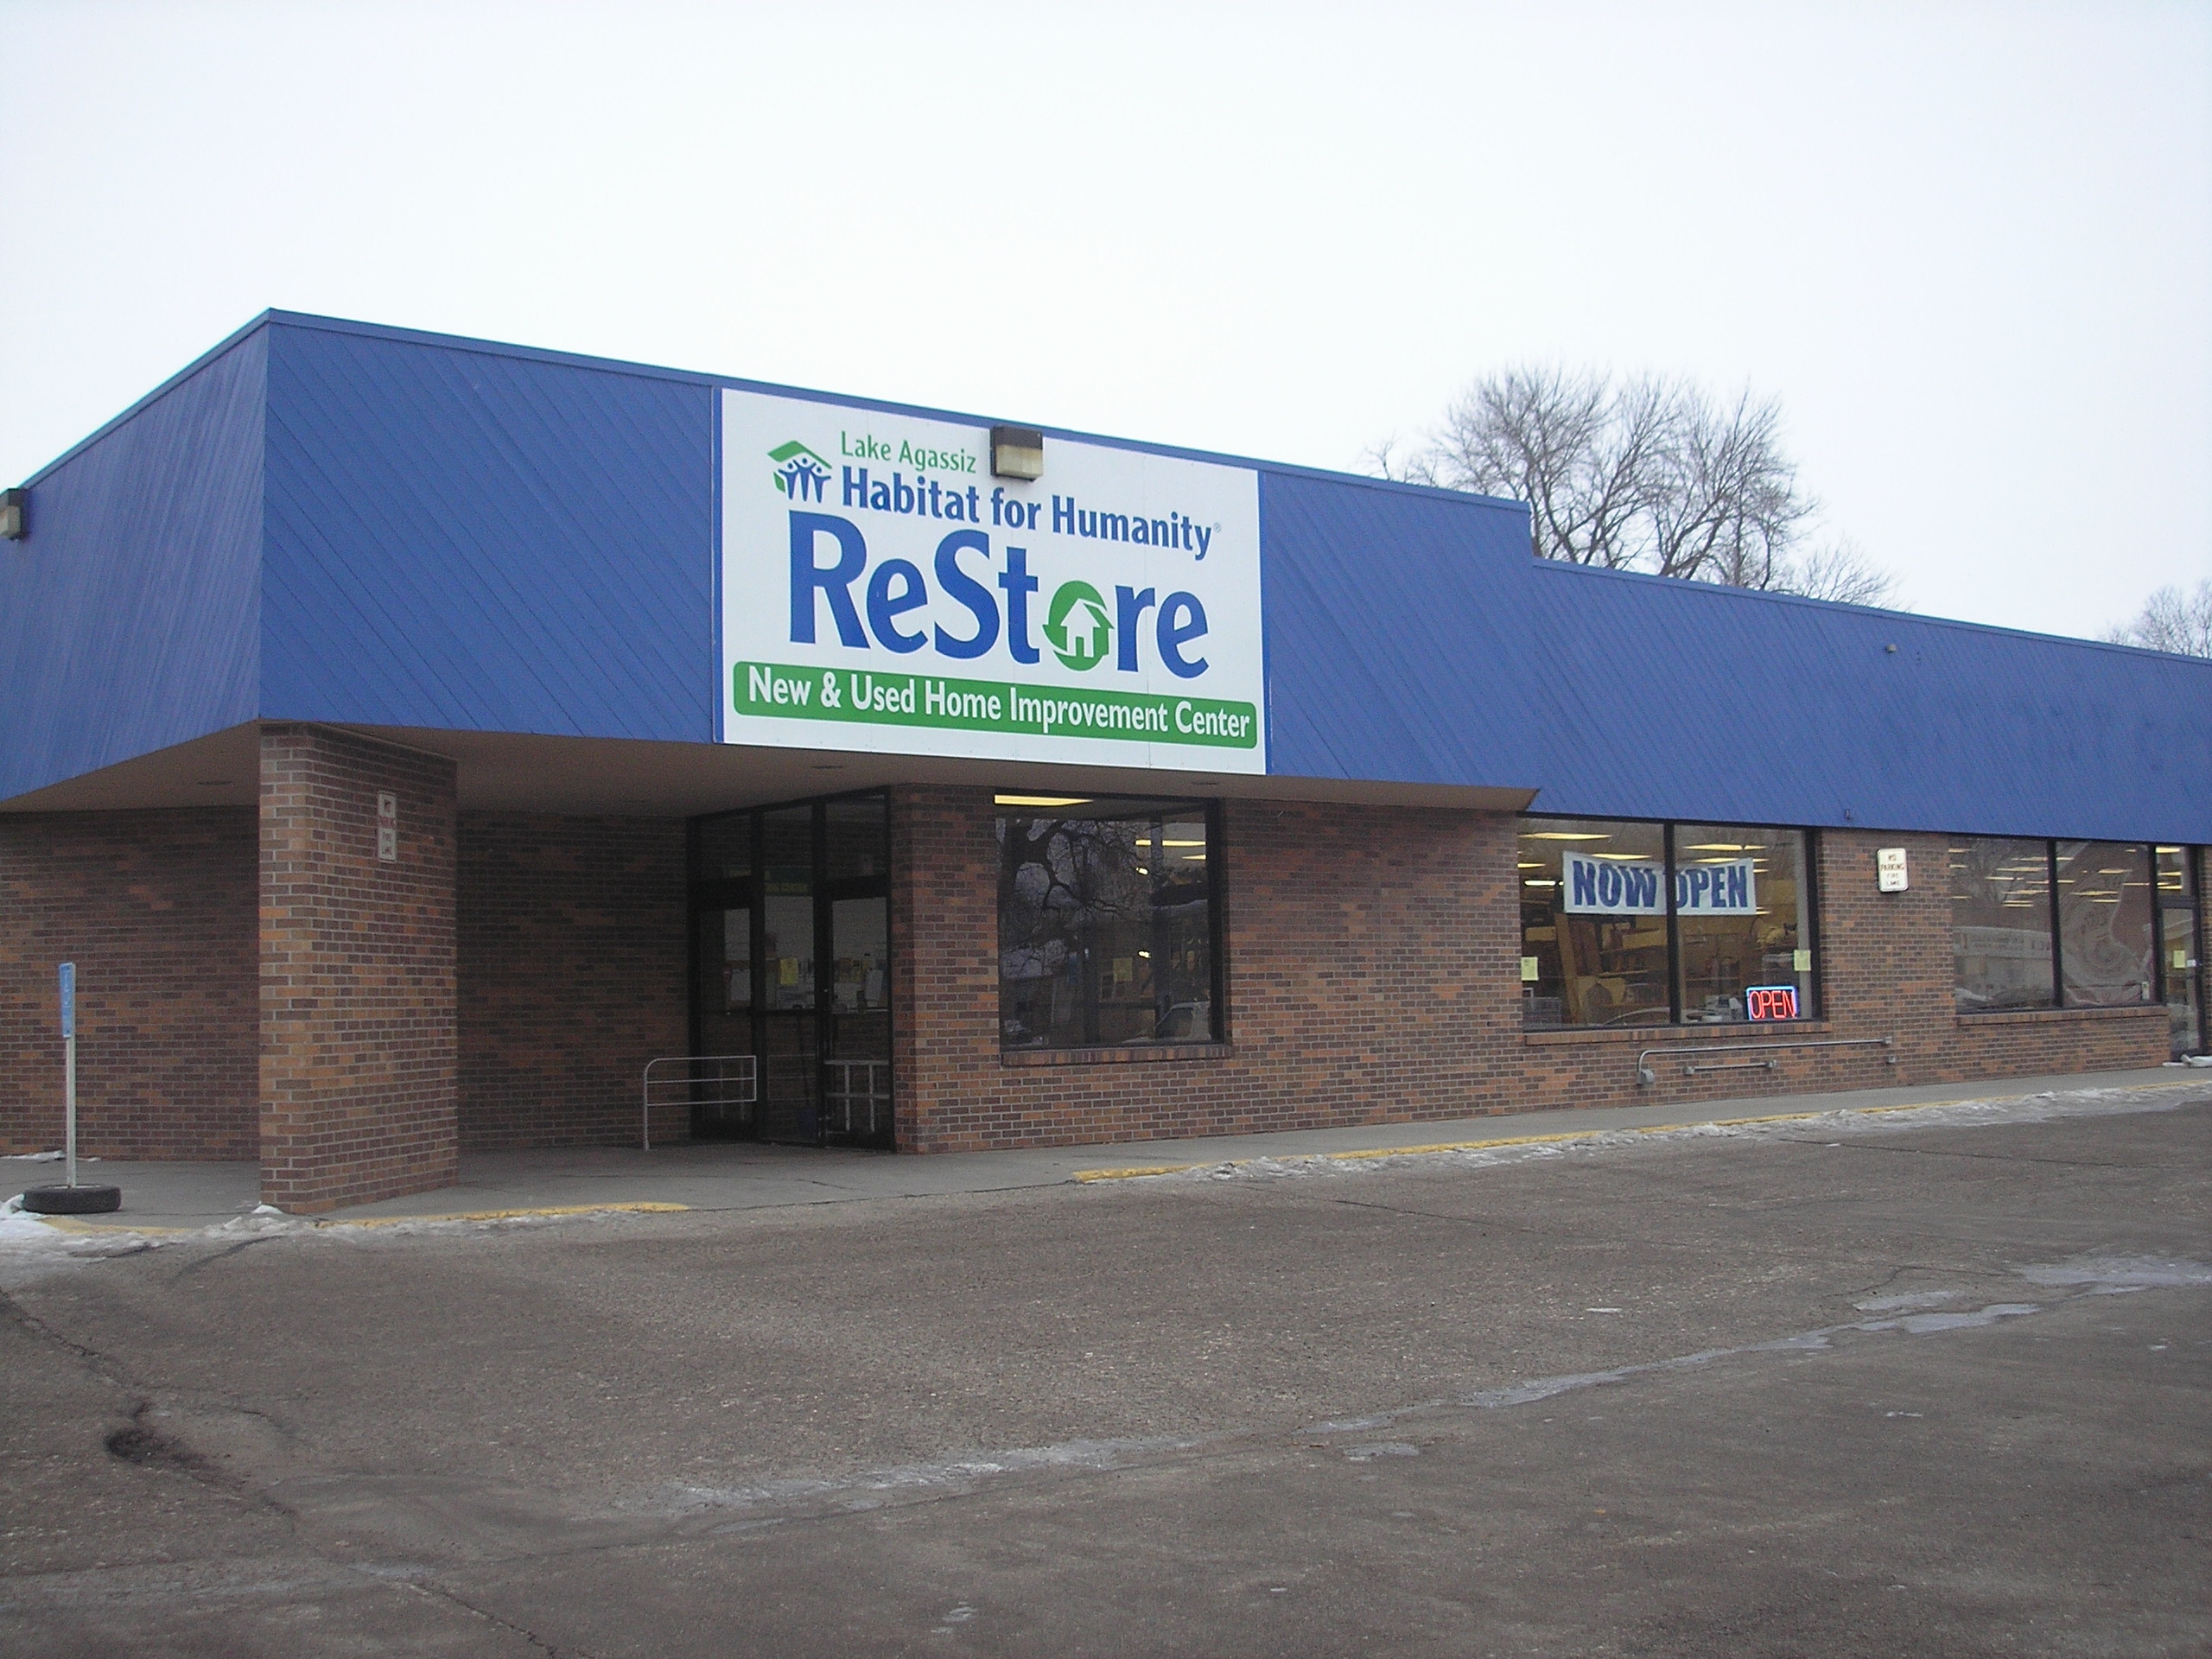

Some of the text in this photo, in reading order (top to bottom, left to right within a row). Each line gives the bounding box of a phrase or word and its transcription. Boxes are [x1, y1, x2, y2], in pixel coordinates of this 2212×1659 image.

[841, 431, 976, 473] Lake Agassiz
[842, 466, 1211, 561] Habitat for Humanity
[748, 665, 1250, 737] New & Used Home Improvement Center
[1573, 861, 1656, 907] NOW
[1749, 990, 1796, 1019] OPEN
